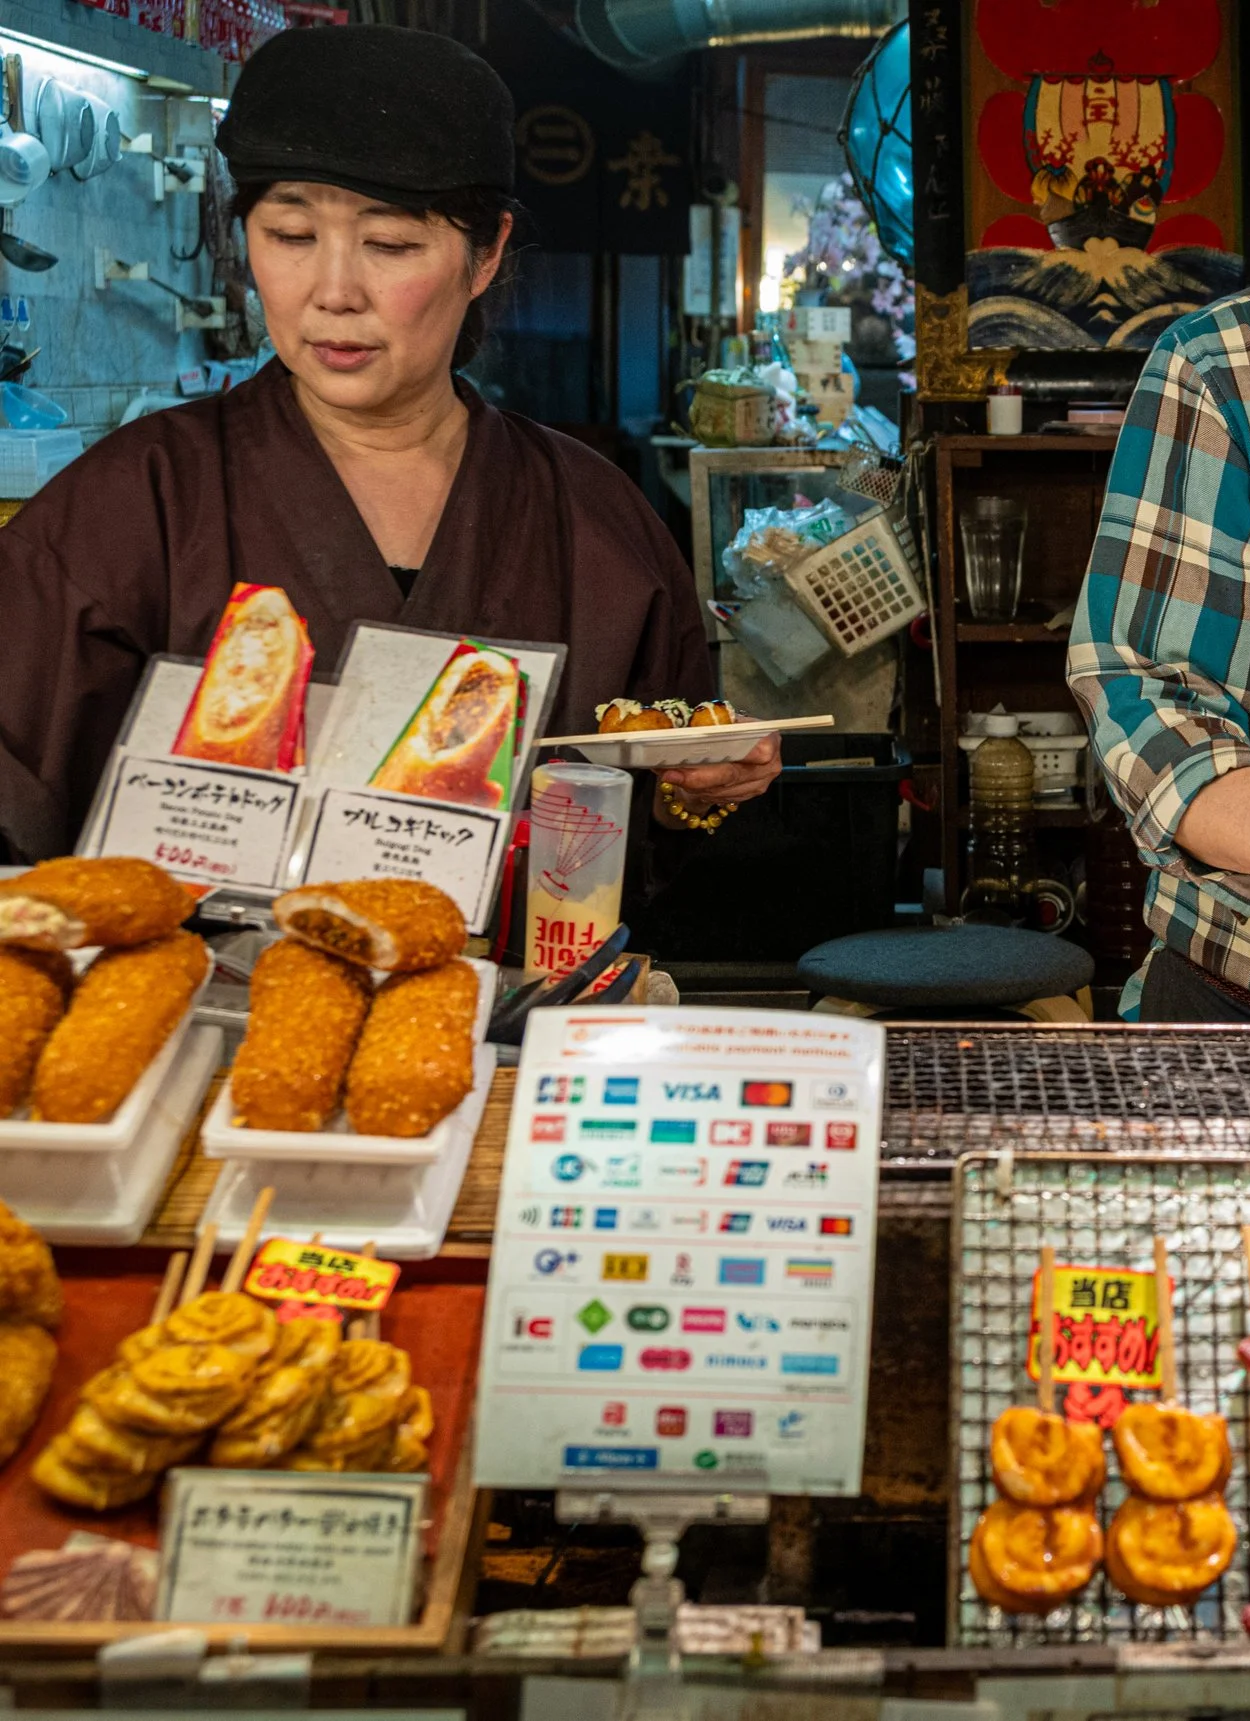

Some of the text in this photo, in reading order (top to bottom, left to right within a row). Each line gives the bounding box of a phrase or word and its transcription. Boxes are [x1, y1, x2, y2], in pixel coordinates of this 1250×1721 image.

[662, 1080, 721, 1101] VISA
[766, 1217, 807, 1232] VISA
[298, 1250, 358, 1272] 当店
[1069, 1277, 1134, 1310] 当店
